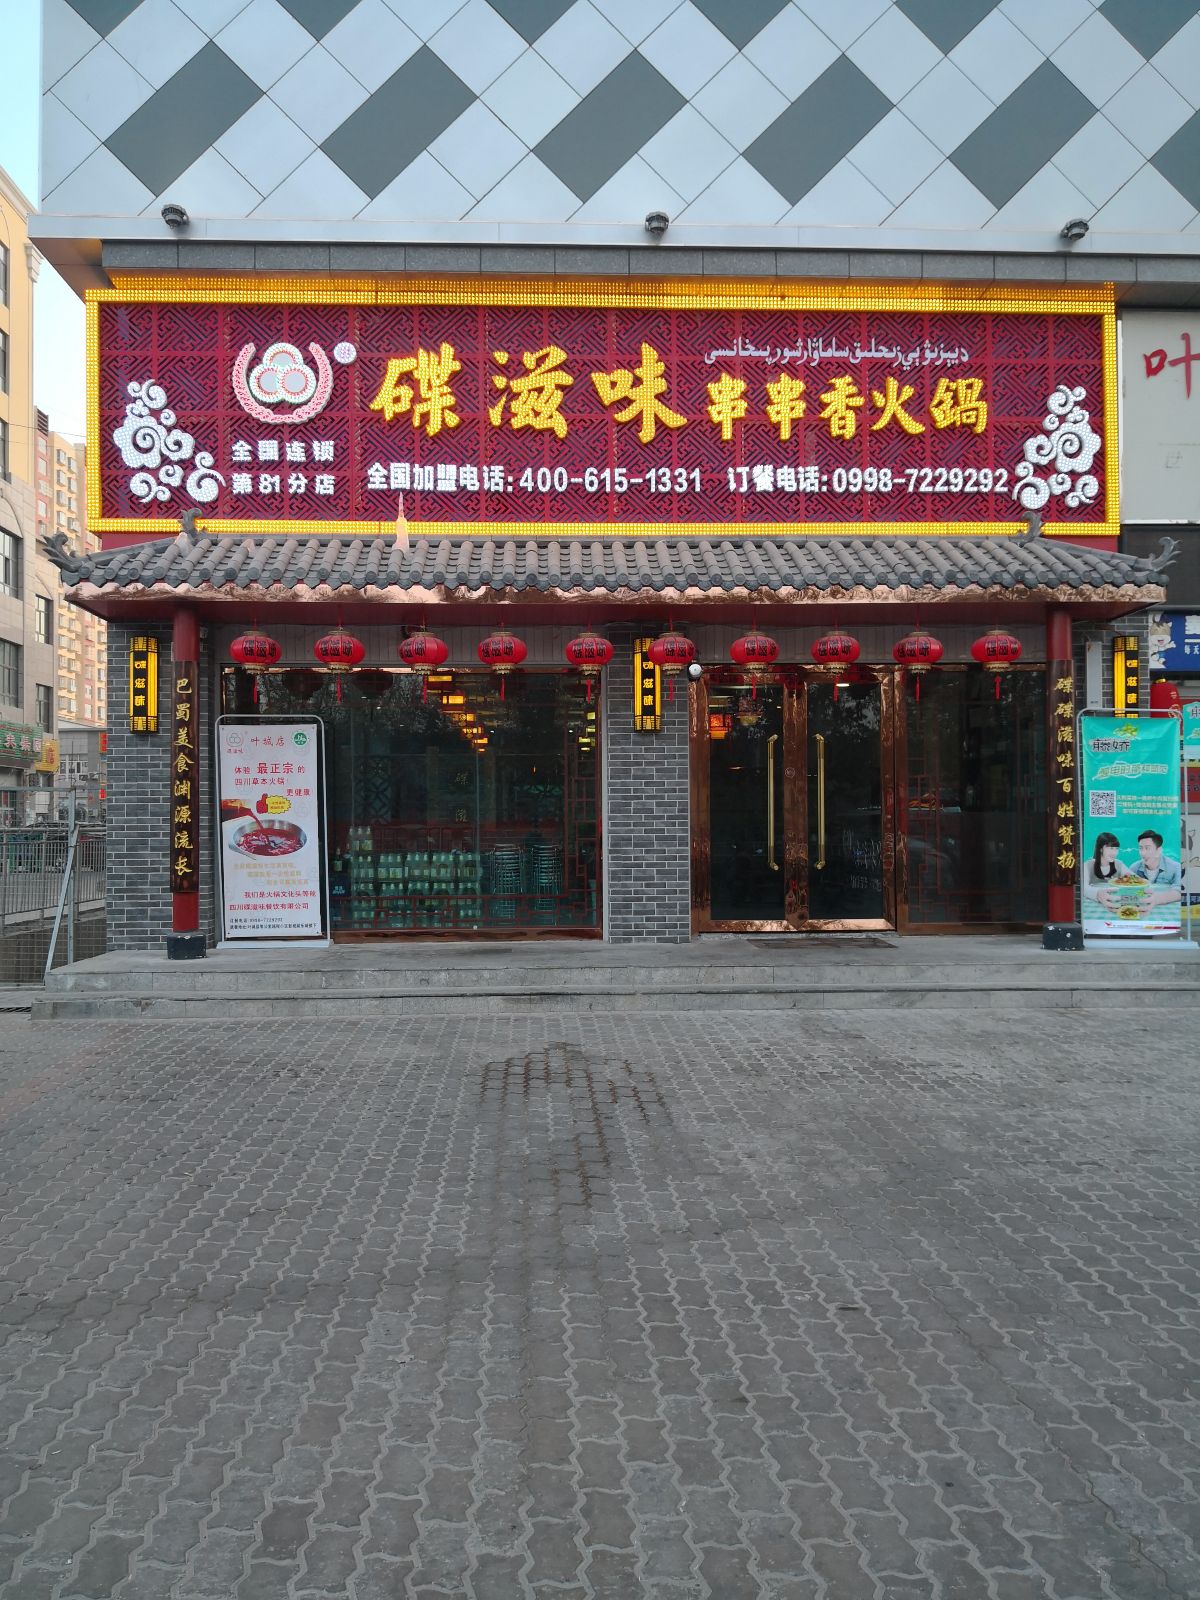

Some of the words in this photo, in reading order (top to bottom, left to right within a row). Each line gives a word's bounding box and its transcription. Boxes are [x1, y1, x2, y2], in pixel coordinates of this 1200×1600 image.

[370, 342, 688, 444] 碟滋味
[232, 439, 335, 462] 全国连锁
[232, 472, 335, 495] 第81分店
